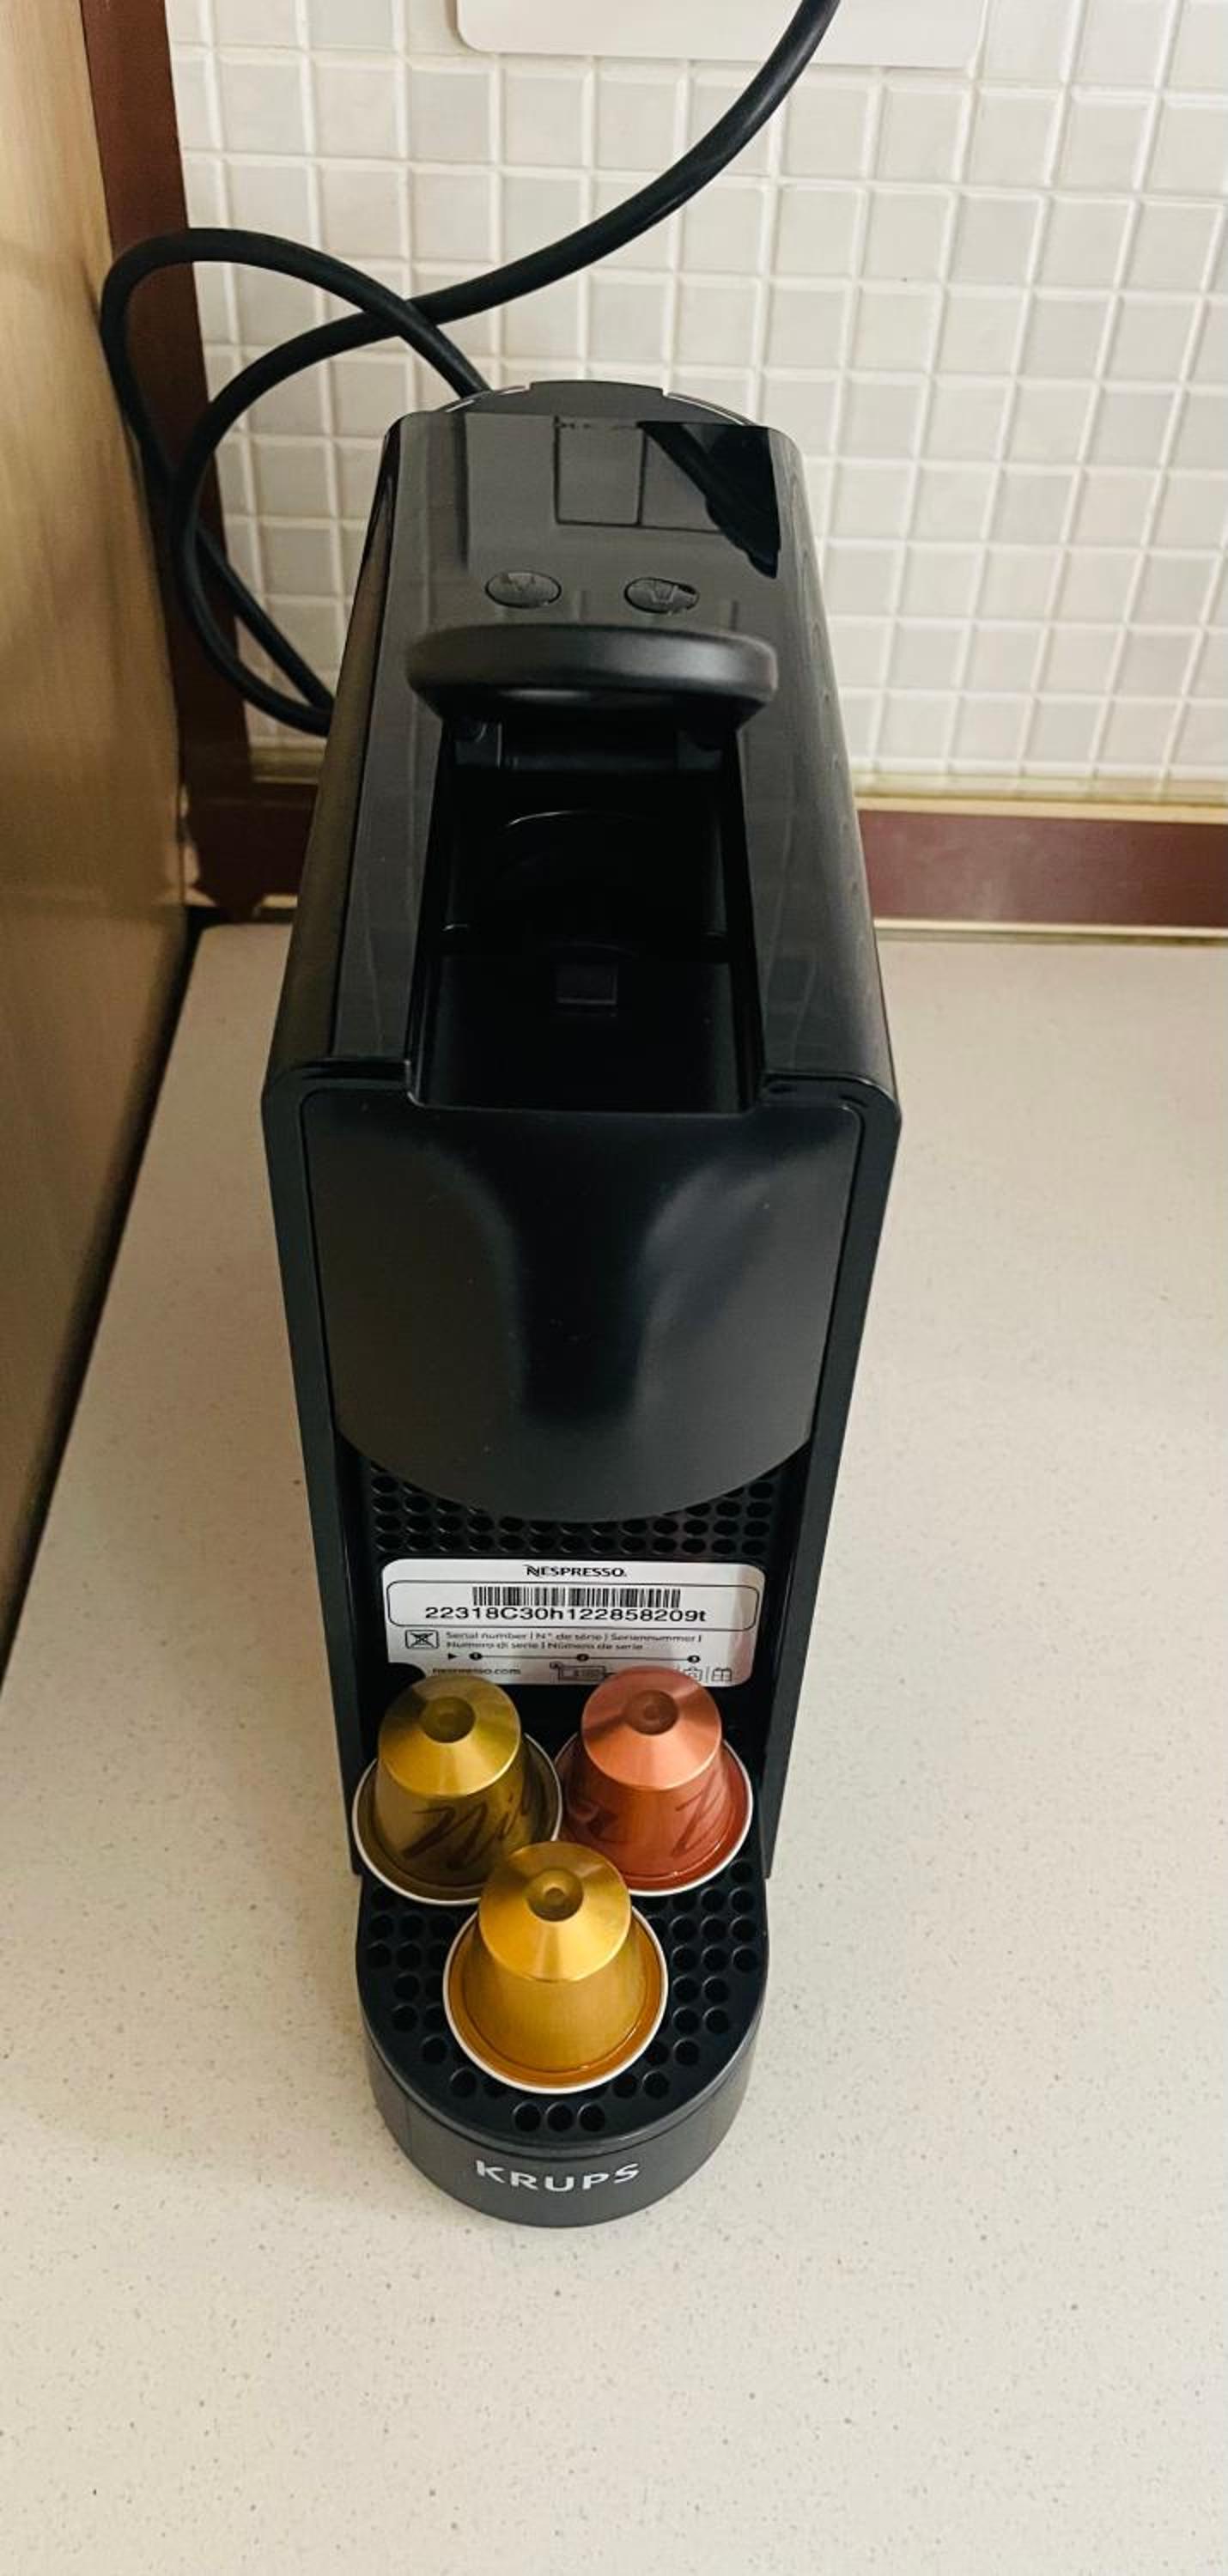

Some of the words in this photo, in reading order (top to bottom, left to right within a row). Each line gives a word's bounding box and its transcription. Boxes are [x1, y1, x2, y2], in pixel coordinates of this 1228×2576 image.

[524, 1564, 624, 1577] NESPRESSO
[425, 1607, 706, 1621] 22318C30h122858209t
[611, 1633, 696, 1642] Seriennummer
[476, 2160, 640, 2191] KRUPS
